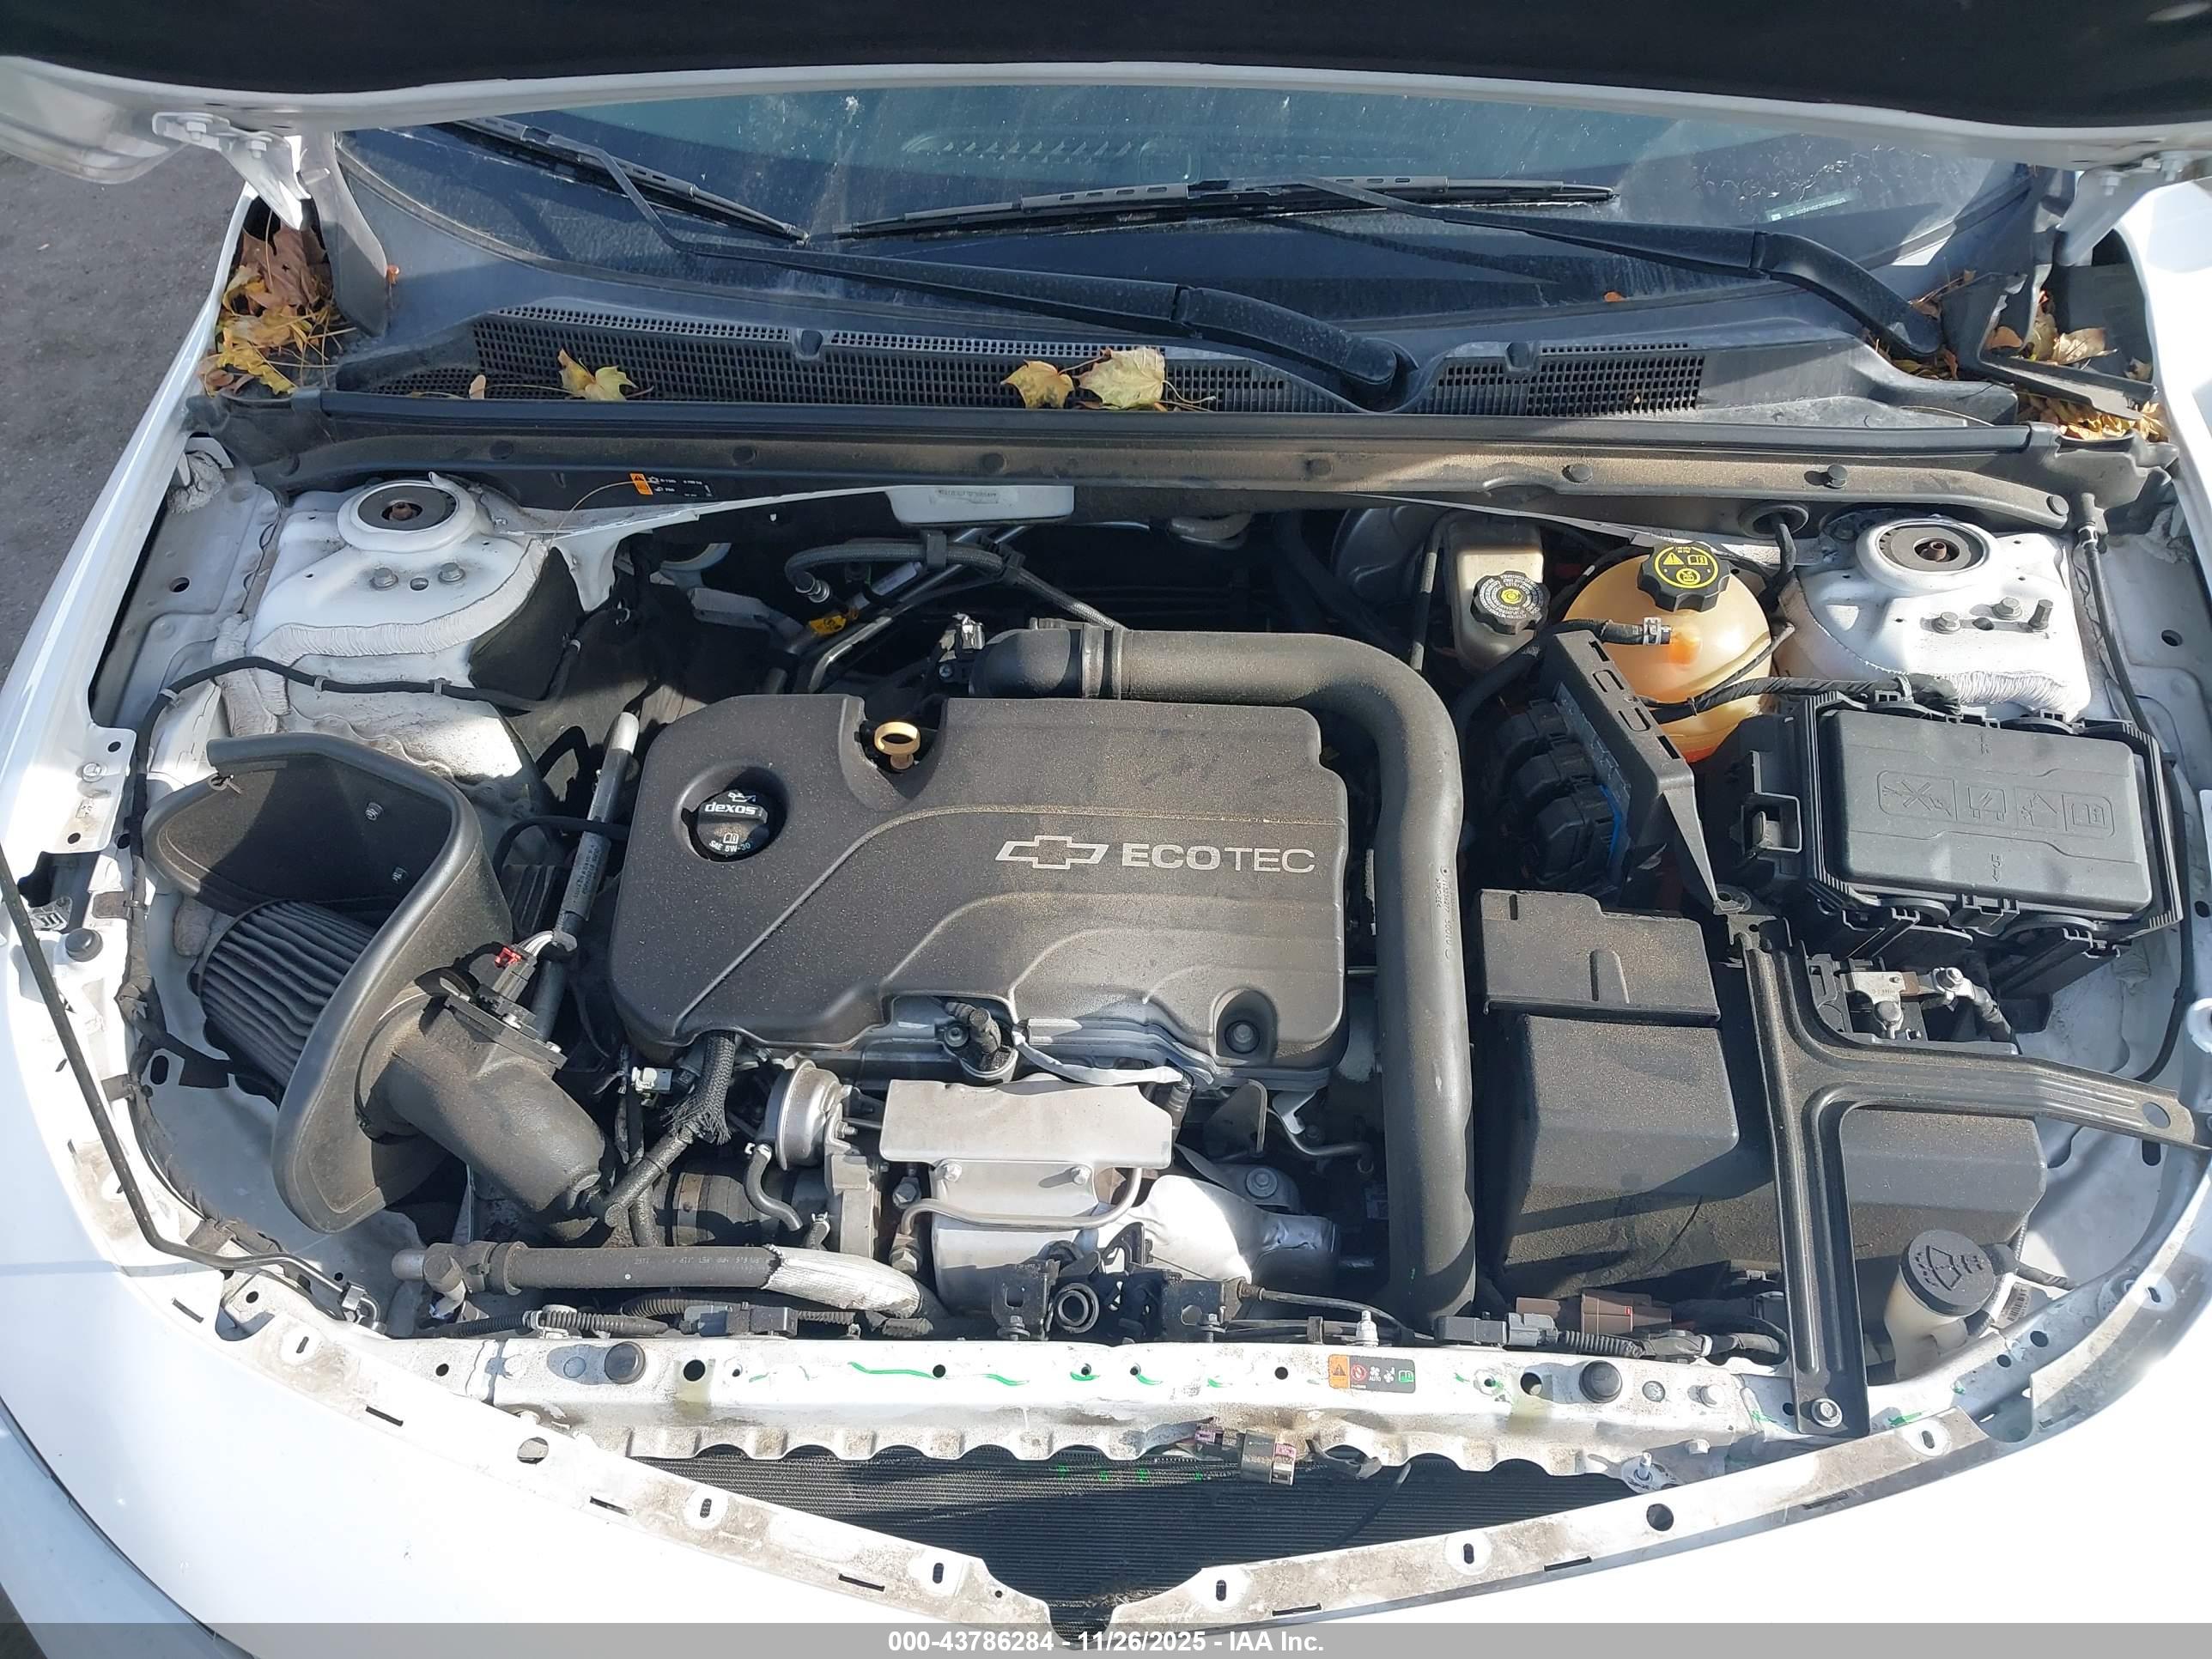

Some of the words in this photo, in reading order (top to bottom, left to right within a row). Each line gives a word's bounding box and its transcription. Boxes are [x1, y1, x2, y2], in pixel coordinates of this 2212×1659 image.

[704, 801, 758, 815] dexos
[709, 840, 723, 852] SAE
[725, 842, 750, 853] 5W-30
[1121, 842, 1316, 874] ECOTEC
